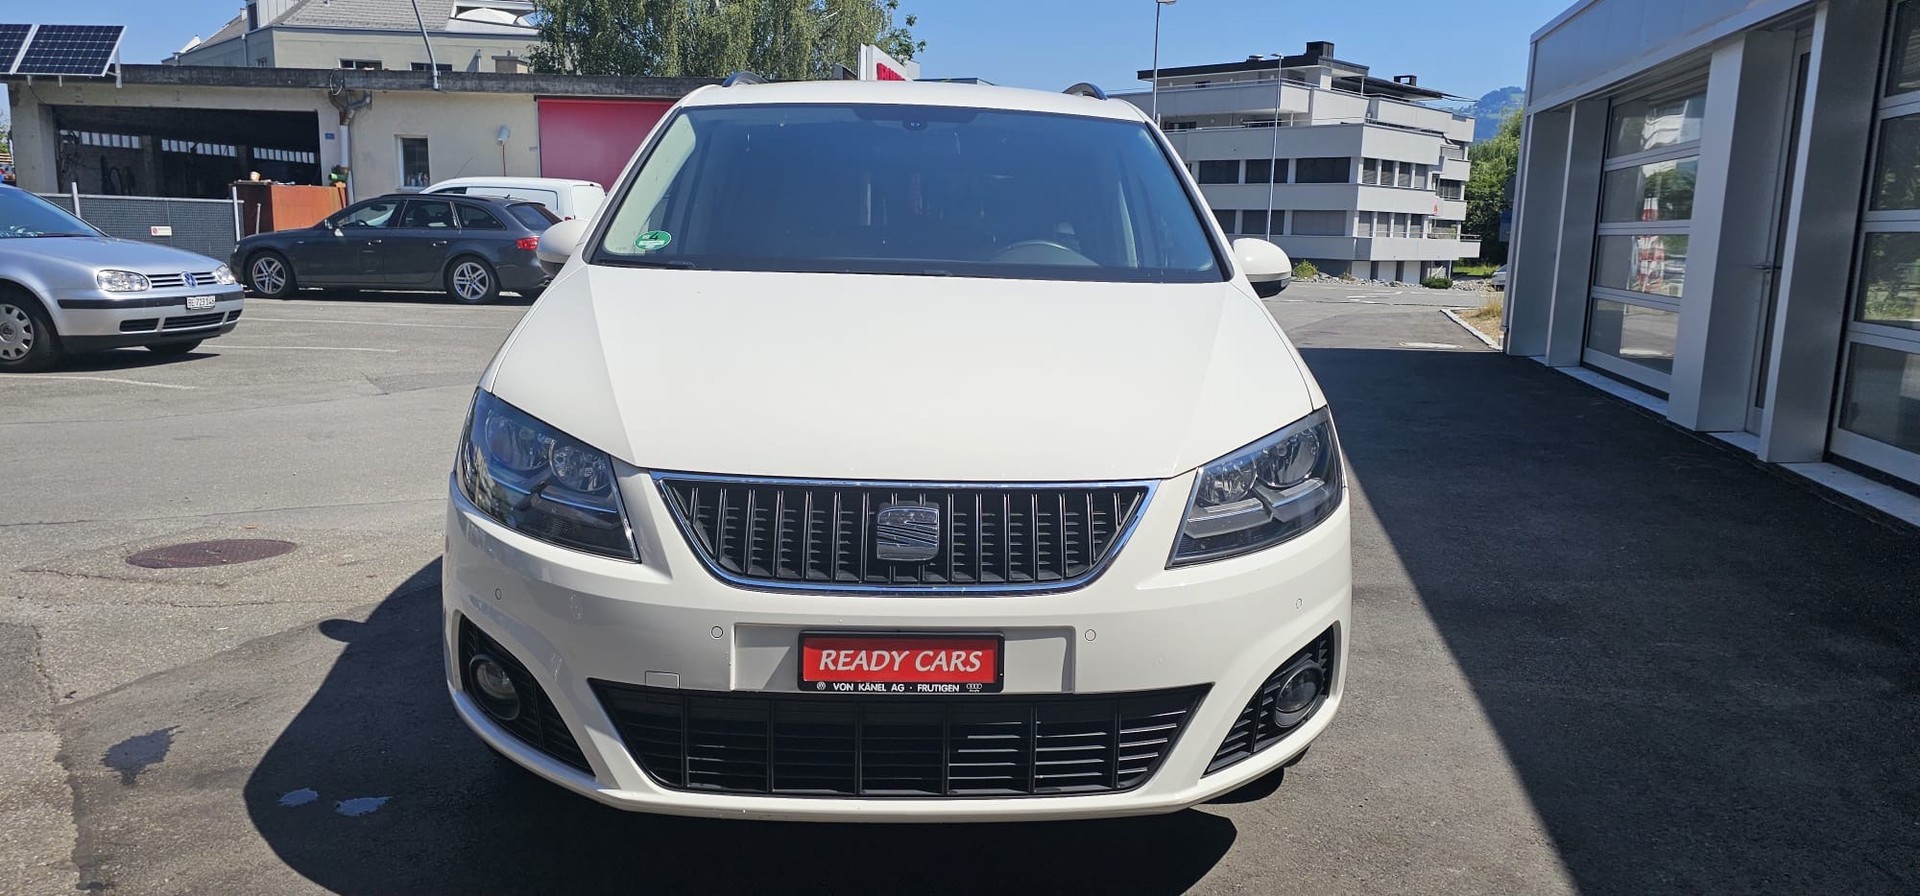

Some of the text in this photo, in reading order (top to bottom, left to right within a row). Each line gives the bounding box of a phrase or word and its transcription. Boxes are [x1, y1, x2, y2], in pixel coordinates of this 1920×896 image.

[649, 232, 659, 240] 4
[819, 650, 982, 672] READY CARS
[833, 683, 853, 692] VON
[859, 682, 887, 692] KÄNEL
[891, 683, 905, 692] AG
[917, 684, 960, 693] FRUTIGEN
